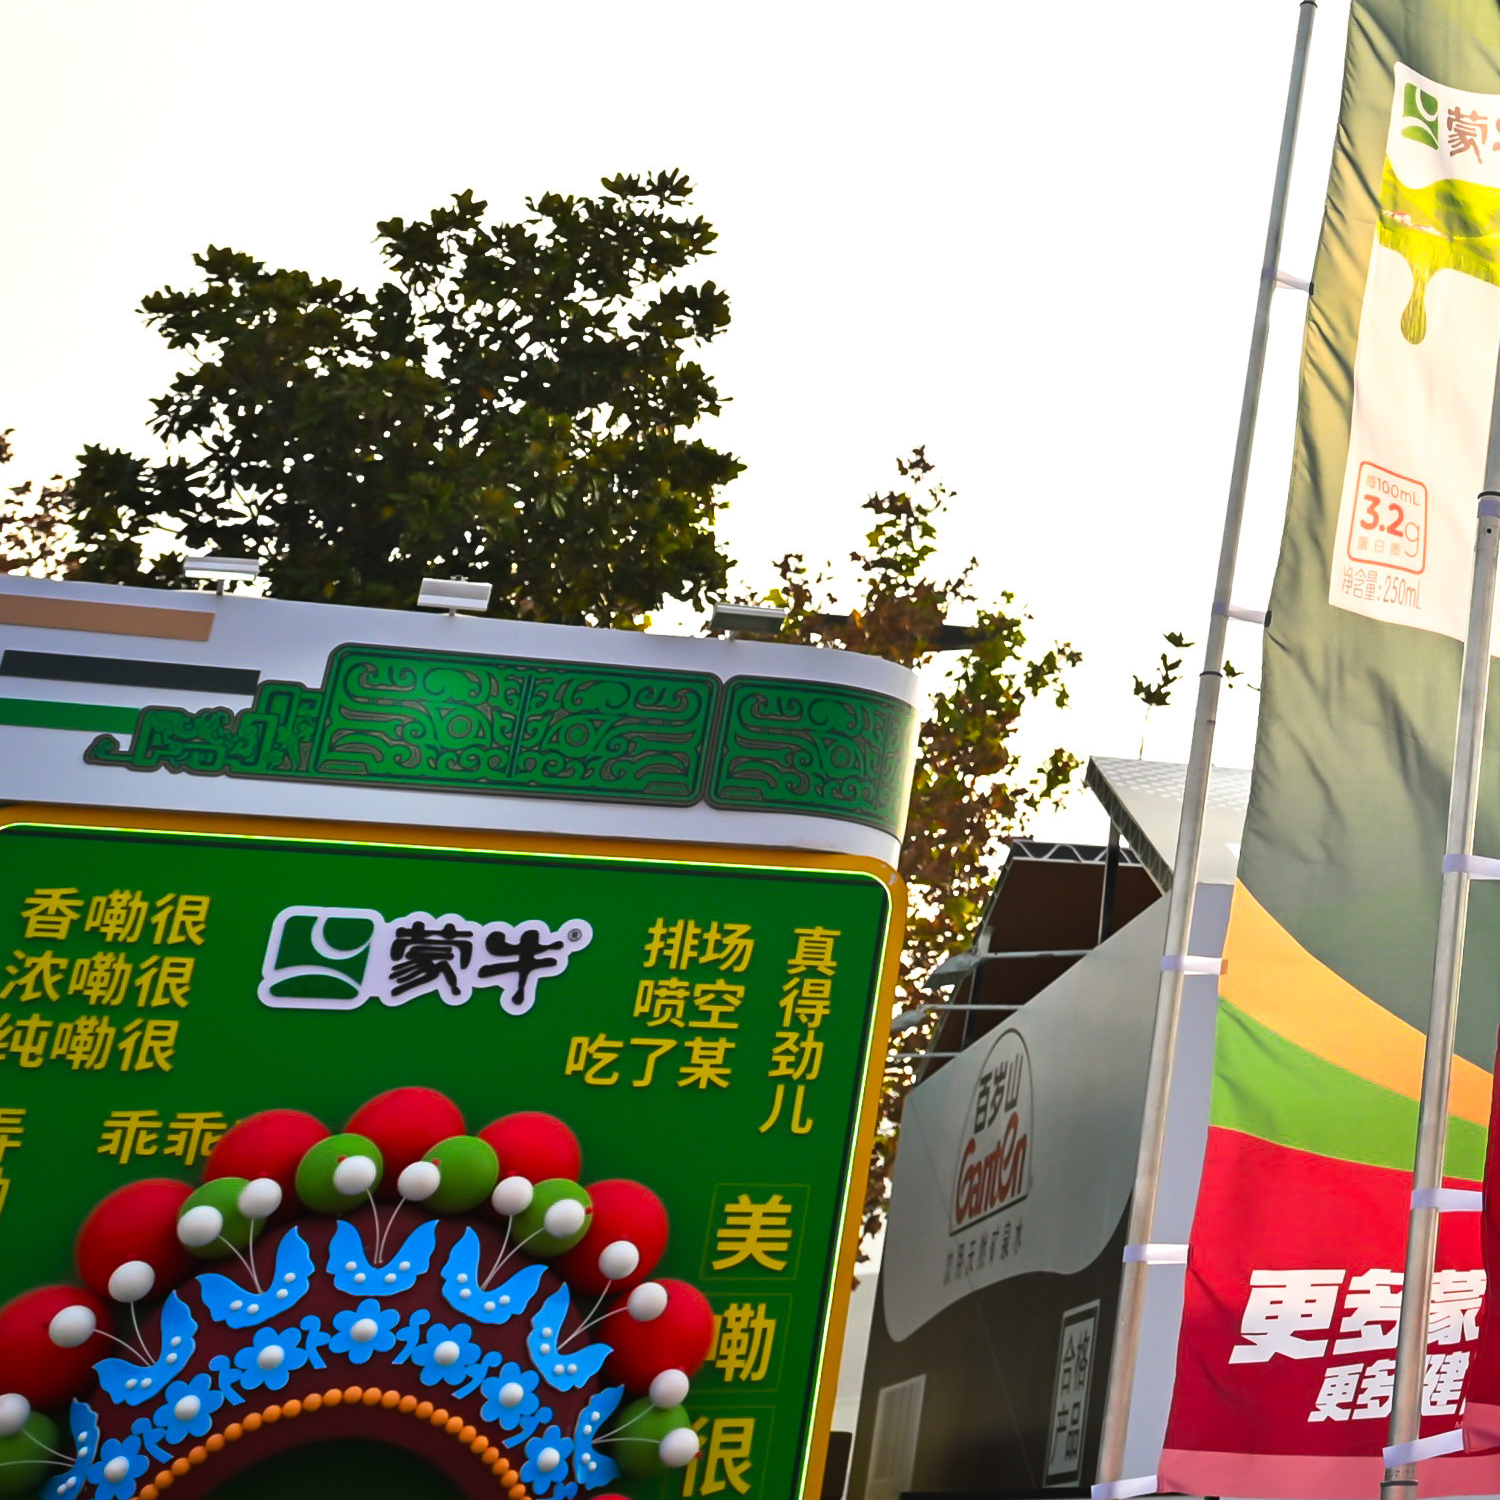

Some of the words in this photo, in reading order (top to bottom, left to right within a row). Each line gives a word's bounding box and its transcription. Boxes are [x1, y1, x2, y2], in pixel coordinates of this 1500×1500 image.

[1360, 494, 1421, 558] 3.2g
[20, 888, 211, 946] 香嘞很
[643, 918, 754, 973] 排场
[0, 950, 196, 1009] 浓嘞很
[389, 921, 564, 1005] 蒙牛
[633, 979, 745, 1030] 喷空
[759, 927, 841, 1134] 真得劲儿
[565, 1034, 735, 1089] 吃了某
[97, 1110, 243, 1166] 乖乖
